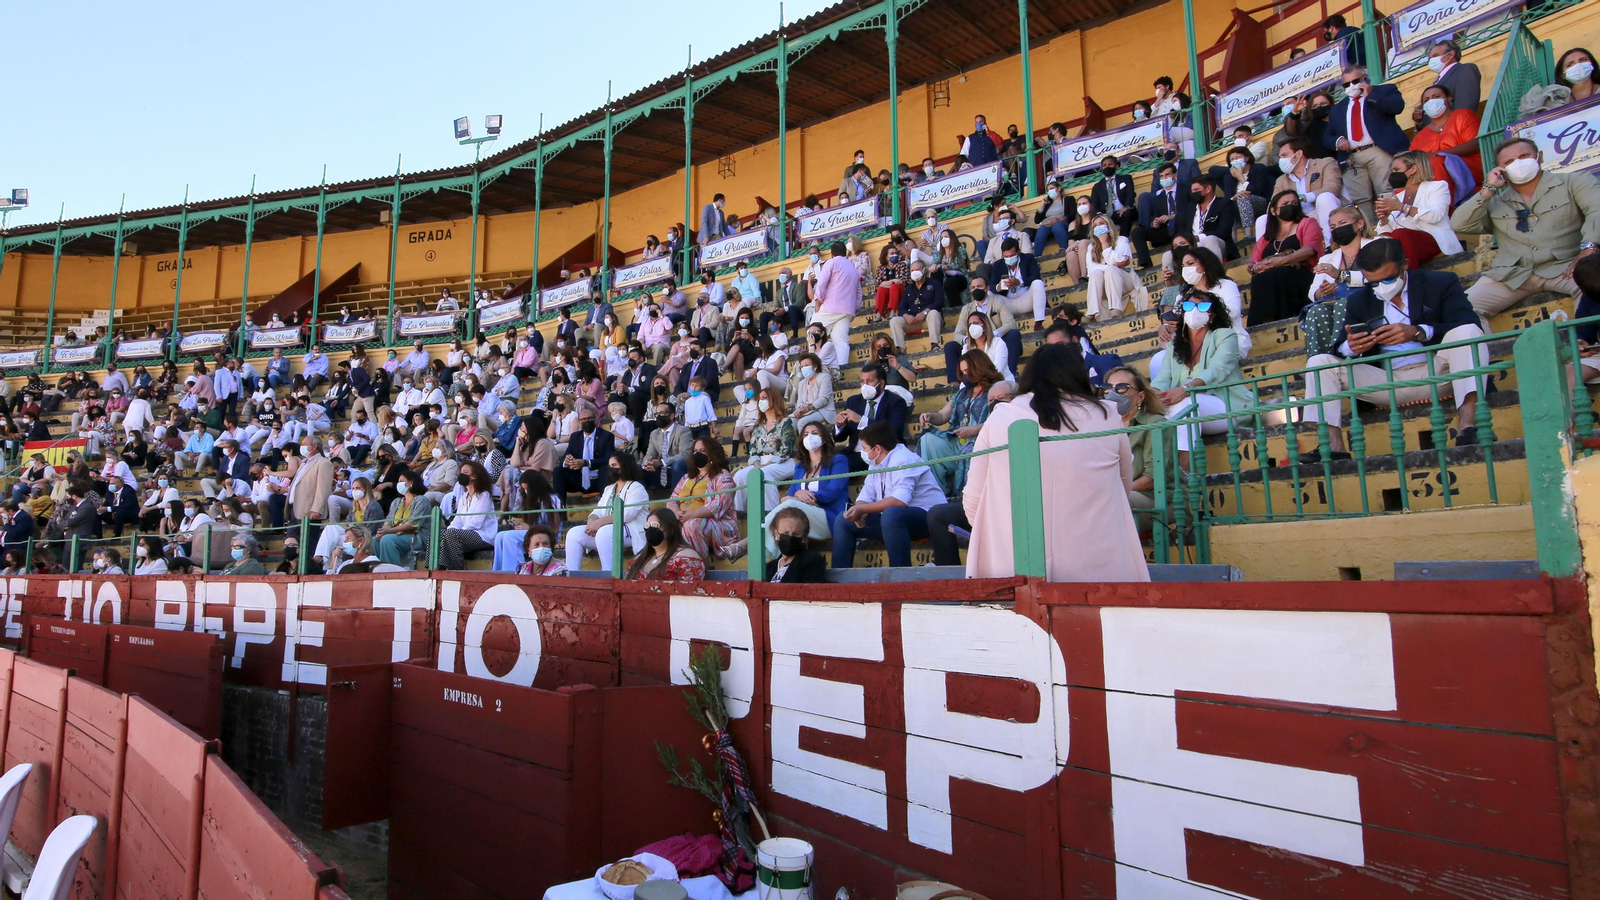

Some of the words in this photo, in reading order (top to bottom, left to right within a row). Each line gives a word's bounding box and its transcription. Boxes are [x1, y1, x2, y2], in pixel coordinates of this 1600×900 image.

[1408, 6, 1456, 33] Peña
[1226, 80, 1286, 113] Peregrinos
[1287, 73, 1301, 86] de
[1313, 59, 1334, 78] pie
[1072, 146, 1089, 161] El
[919, 189, 939, 202] Los
[940, 178, 990, 197] Romeritos
[809, 217, 827, 232] La
[828, 210, 866, 228] Trasera
[409, 229, 452, 244] GRADA
[706, 247, 723, 259] Los
[157, 258, 193, 272] GRADA
[1142, 273, 1158, 286] 29
[1129, 318, 1146, 333] 29
[1276, 325, 1300, 343] 31
[856, 348, 871, 360] 22
[1291, 481, 1328, 505] 31
[1410, 470, 1460, 498] 32
[57, 579, 122, 625] TIO
[154, 580, 332, 686] PEPE
[129, 636, 155, 646] EMPLEADOS
[443, 687, 484, 709] EMPRESA
[495, 699, 502, 712] 2
[372, 578, 543, 688] TIO
[668, 594, 1398, 900] PEPE
